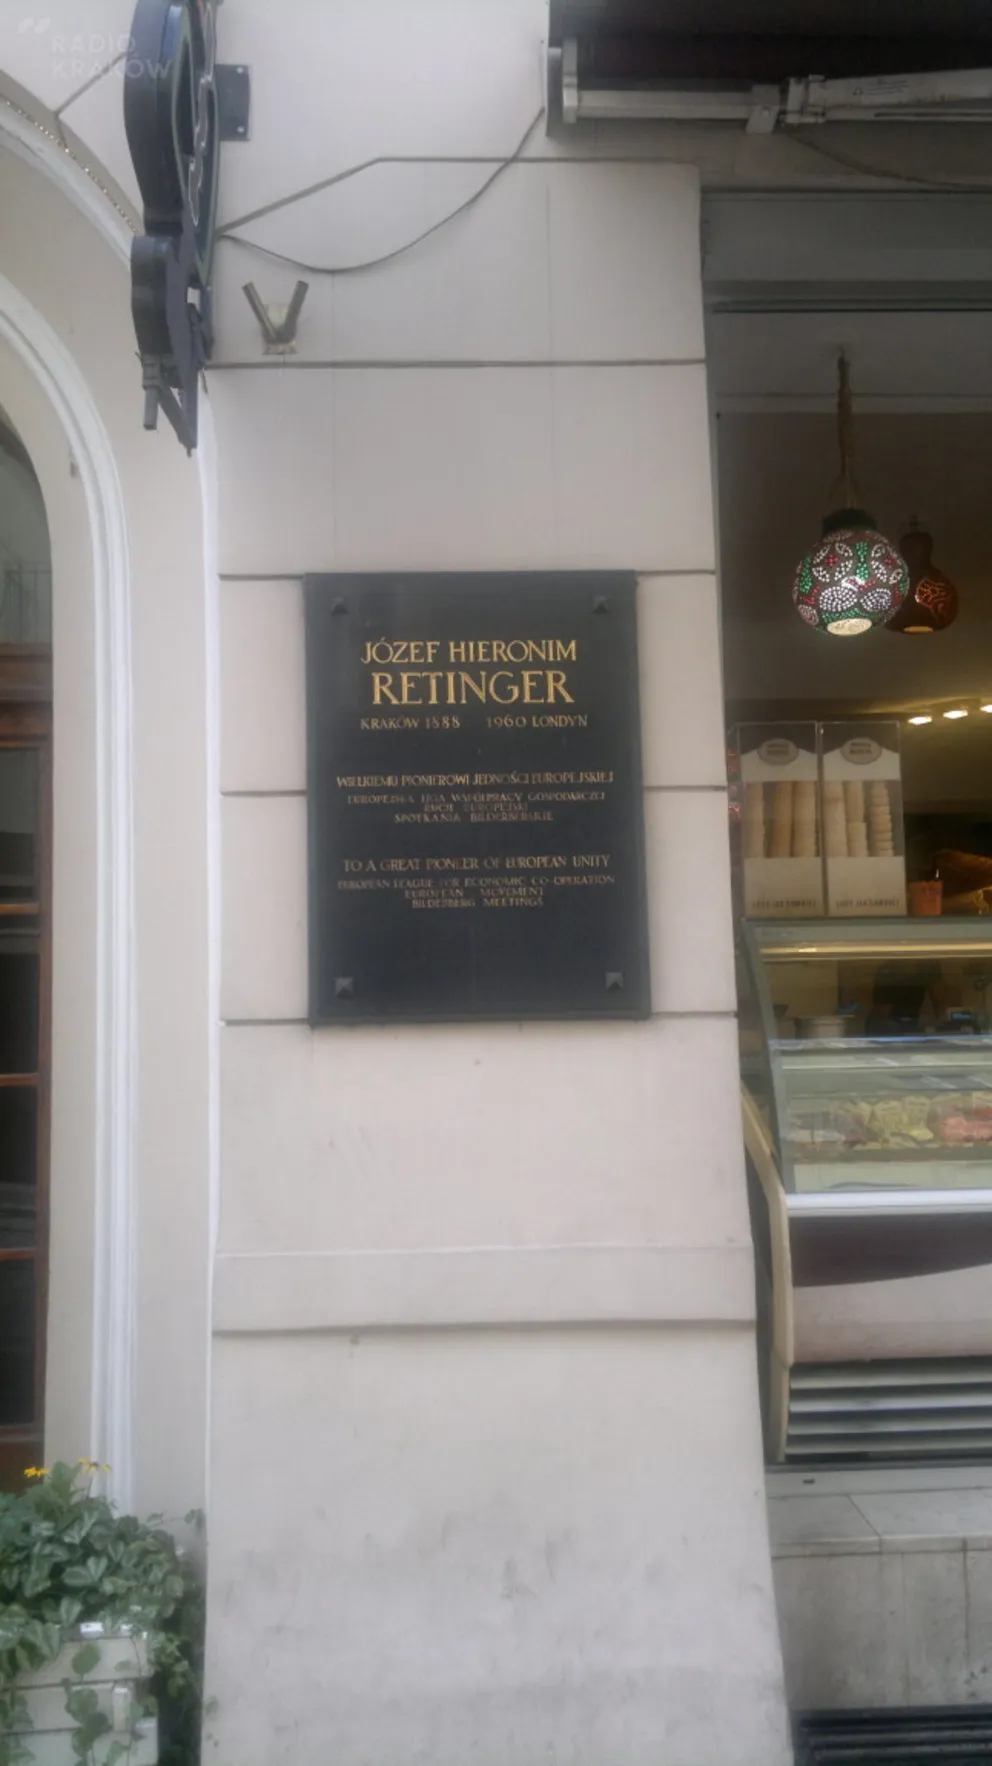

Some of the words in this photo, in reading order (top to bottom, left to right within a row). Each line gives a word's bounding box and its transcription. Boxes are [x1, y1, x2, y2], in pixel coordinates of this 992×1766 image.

[361, 637, 440, 664] JÓZEF
[449, 639, 577, 663] HIERONIM
[371, 670, 576, 705] RETINGER
[425, 716, 461, 729] 1888
[486, 714, 526, 729] 1960
[532, 714, 588, 728] LONDYN
[401, 774, 470, 787] PIONIEROWI
[472, 771, 529, 786] JEDNOŚCI
[532, 771, 614, 784] EUROPEJSKIEJ
[343, 859, 363, 872] TO
[366, 859, 376, 872] A
[380, 857, 420, 872] GREAT
[425, 856, 479, 871] PIONEER
[483, 857, 500, 869] OF
[505, 855, 567, 869] EUROPEAN
[572, 854, 611, 868] UNITY
